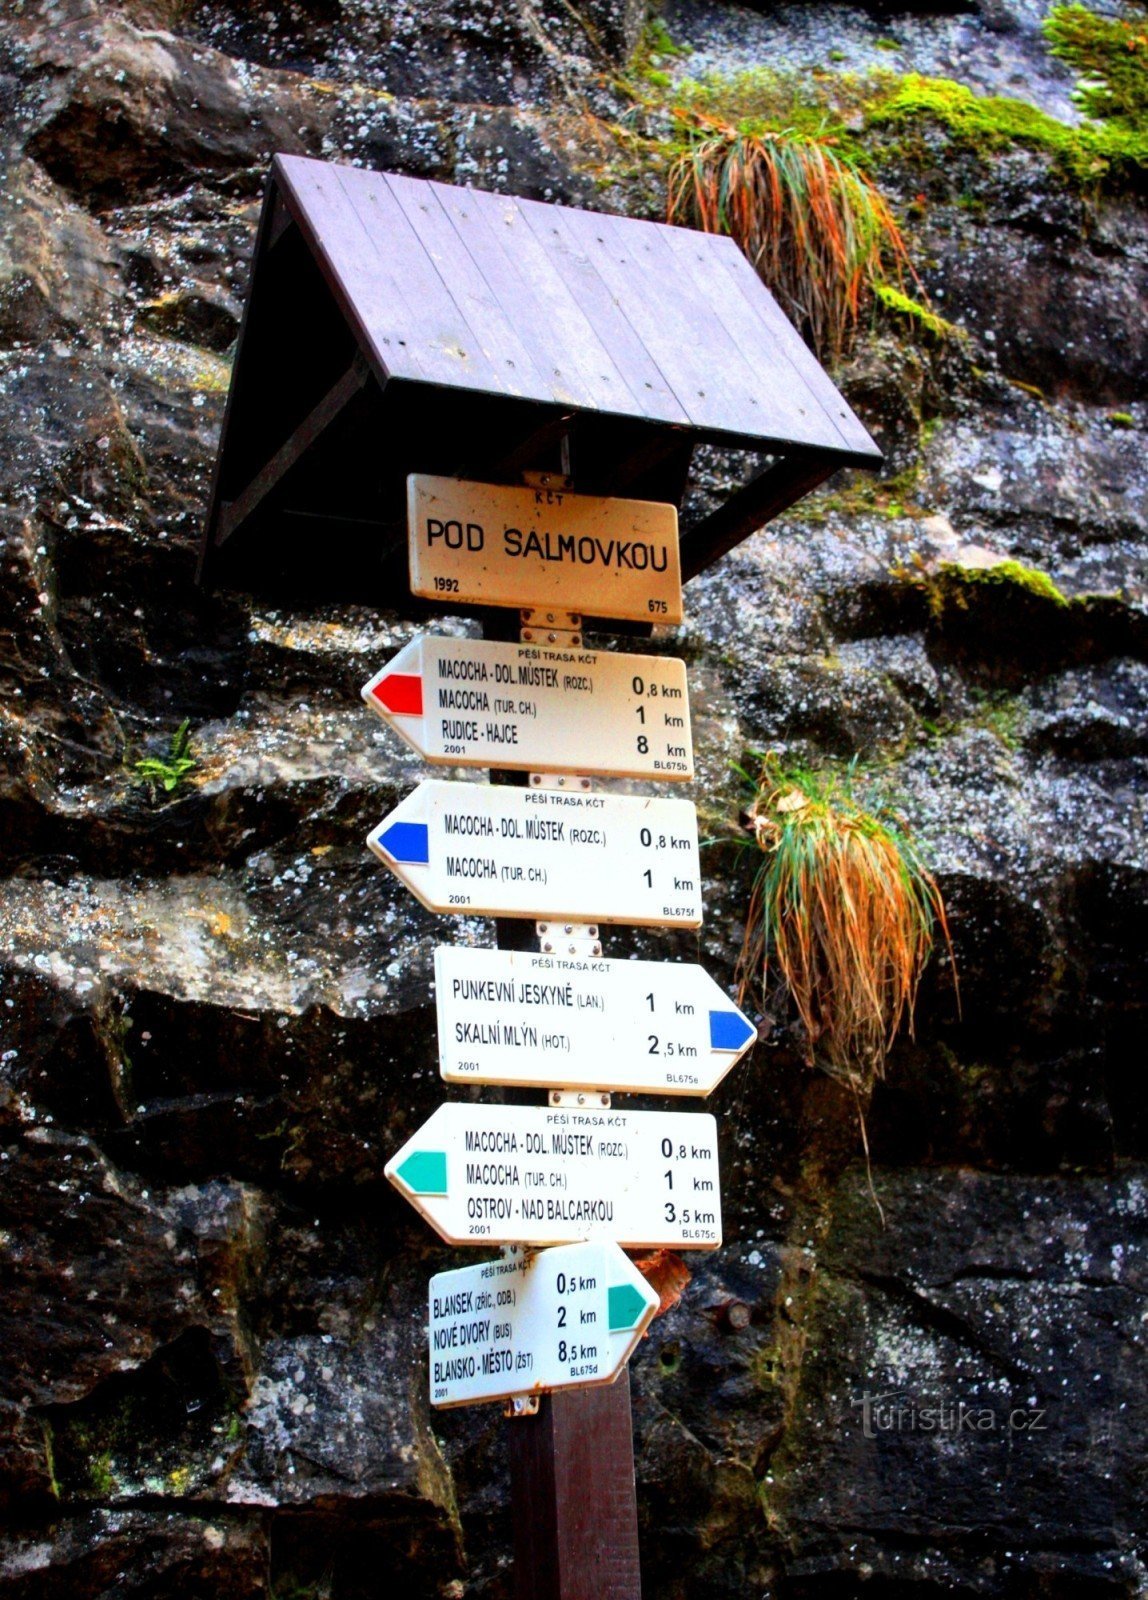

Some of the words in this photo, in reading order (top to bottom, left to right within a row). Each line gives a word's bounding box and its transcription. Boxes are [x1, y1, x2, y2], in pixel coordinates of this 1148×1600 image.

[427, 519, 484, 552] POD
[504, 528, 668, 572] SALMOVKOU
[433, 576, 459, 593] 1992
[648, 599, 668, 614] 675
[543, 651, 576, 663] TRASA
[578, 655, 598, 665] KČT
[438, 658, 488, 682] MACOCHA
[495, 664, 518, 685] DOL.
[518, 661, 559, 688] MŮSTEK
[563, 676, 594, 694] (ROZC.)
[632, 676, 658, 698] 0,8
[661, 684, 682, 698] km
[438, 688, 490, 713] MACOCHA
[493, 699, 518, 715] (TUR.
[519, 701, 537, 719] CH.)
[635, 705, 646, 725] 1
[664, 713, 684, 727] km
[442, 719, 478, 741] RUDICE
[486, 723, 518, 744] HAJCE
[444, 744, 466, 754] 2001
[637, 735, 649, 754] 8
[666, 743, 686, 757] km
[653, 760, 688, 771] BL675b
[550, 796, 584, 807] TRASA
[586, 798, 605, 808] KČT
[444, 814, 494, 837] MACOCHA
[501, 818, 524, 839] DOL.
[525, 814, 565, 842] MŮSTEK
[569, 828, 607, 848] (ROZC.)
[640, 828, 667, 850] 0,8
[670, 836, 691, 850] km
[446, 856, 498, 880] MACOCHA
[501, 866, 527, 883] (TUR.
[528, 868, 548, 885] CH.)
[643, 869, 653, 888] 1
[674, 877, 694, 891] km
[448, 895, 471, 904] 2001
[662, 907, 695, 917] BL675f
[557, 961, 590, 971] TRASA
[591, 963, 611, 973] KČT
[453, 978, 516, 1003] PUNKEVNÍ
[518, 982, 574, 1007] JESKYNĚ
[576, 994, 605, 1013] (LAN.)
[645, 992, 655, 1012] 1
[675, 1001, 695, 1015] km
[455, 1020, 501, 1045] SKALNÍ
[503, 1022, 538, 1047] MLÝN
[541, 1035, 571, 1053] (HOT.)
[647, 1035, 674, 1058] 2,5
[677, 1043, 698, 1057] km
[458, 1061, 480, 1071] 2001
[666, 1074, 699, 1084] BL675e
[572, 1116, 605, 1126] TRASA
[607, 1117, 627, 1127] KČT
[465, 1131, 518, 1153] MACOCHA
[526, 1133, 549, 1154] DOL.
[552, 1128, 593, 1155] MŮSTEK
[597, 1143, 628, 1160] (ROZC.)
[661, 1138, 687, 1160] 0,8
[691, 1146, 711, 1159] km
[466, 1164, 520, 1186] MACOCHA
[524, 1172, 547, 1189] (TUR.
[549, 1174, 568, 1190] CH.)
[664, 1170, 673, 1190] 1
[693, 1178, 713, 1191] km
[467, 1198, 513, 1219] OSTROV
[521, 1200, 545, 1220] NAD
[547, 1200, 614, 1222] BALCARKOU
[664, 1203, 690, 1225] 3,5
[694, 1210, 715, 1224] km
[469, 1225, 491, 1234] 2001
[682, 1230, 716, 1239] BL675c
[496, 1263, 517, 1275] TRASA
[556, 1273, 577, 1295] 0,5
[579, 1277, 597, 1291] km
[433, 1291, 473, 1319] BLANSEK
[497, 1289, 516, 1307] ODB.)
[557, 1306, 566, 1328] 2
[580, 1310, 597, 1324] km
[434, 1322, 458, 1350] NOVÉ
[460, 1320, 491, 1346] DVORY
[493, 1323, 512, 1342] (BUS)
[558, 1341, 577, 1363] 8,5
[580, 1345, 597, 1359] km
[434, 1356, 475, 1383] BLANSKO
[482, 1348, 513, 1375] MĚSTO
[515, 1350, 533, 1373] (ŽST)
[570, 1365, 598, 1377] BL675d
[434, 1388, 448, 1398] 2001
